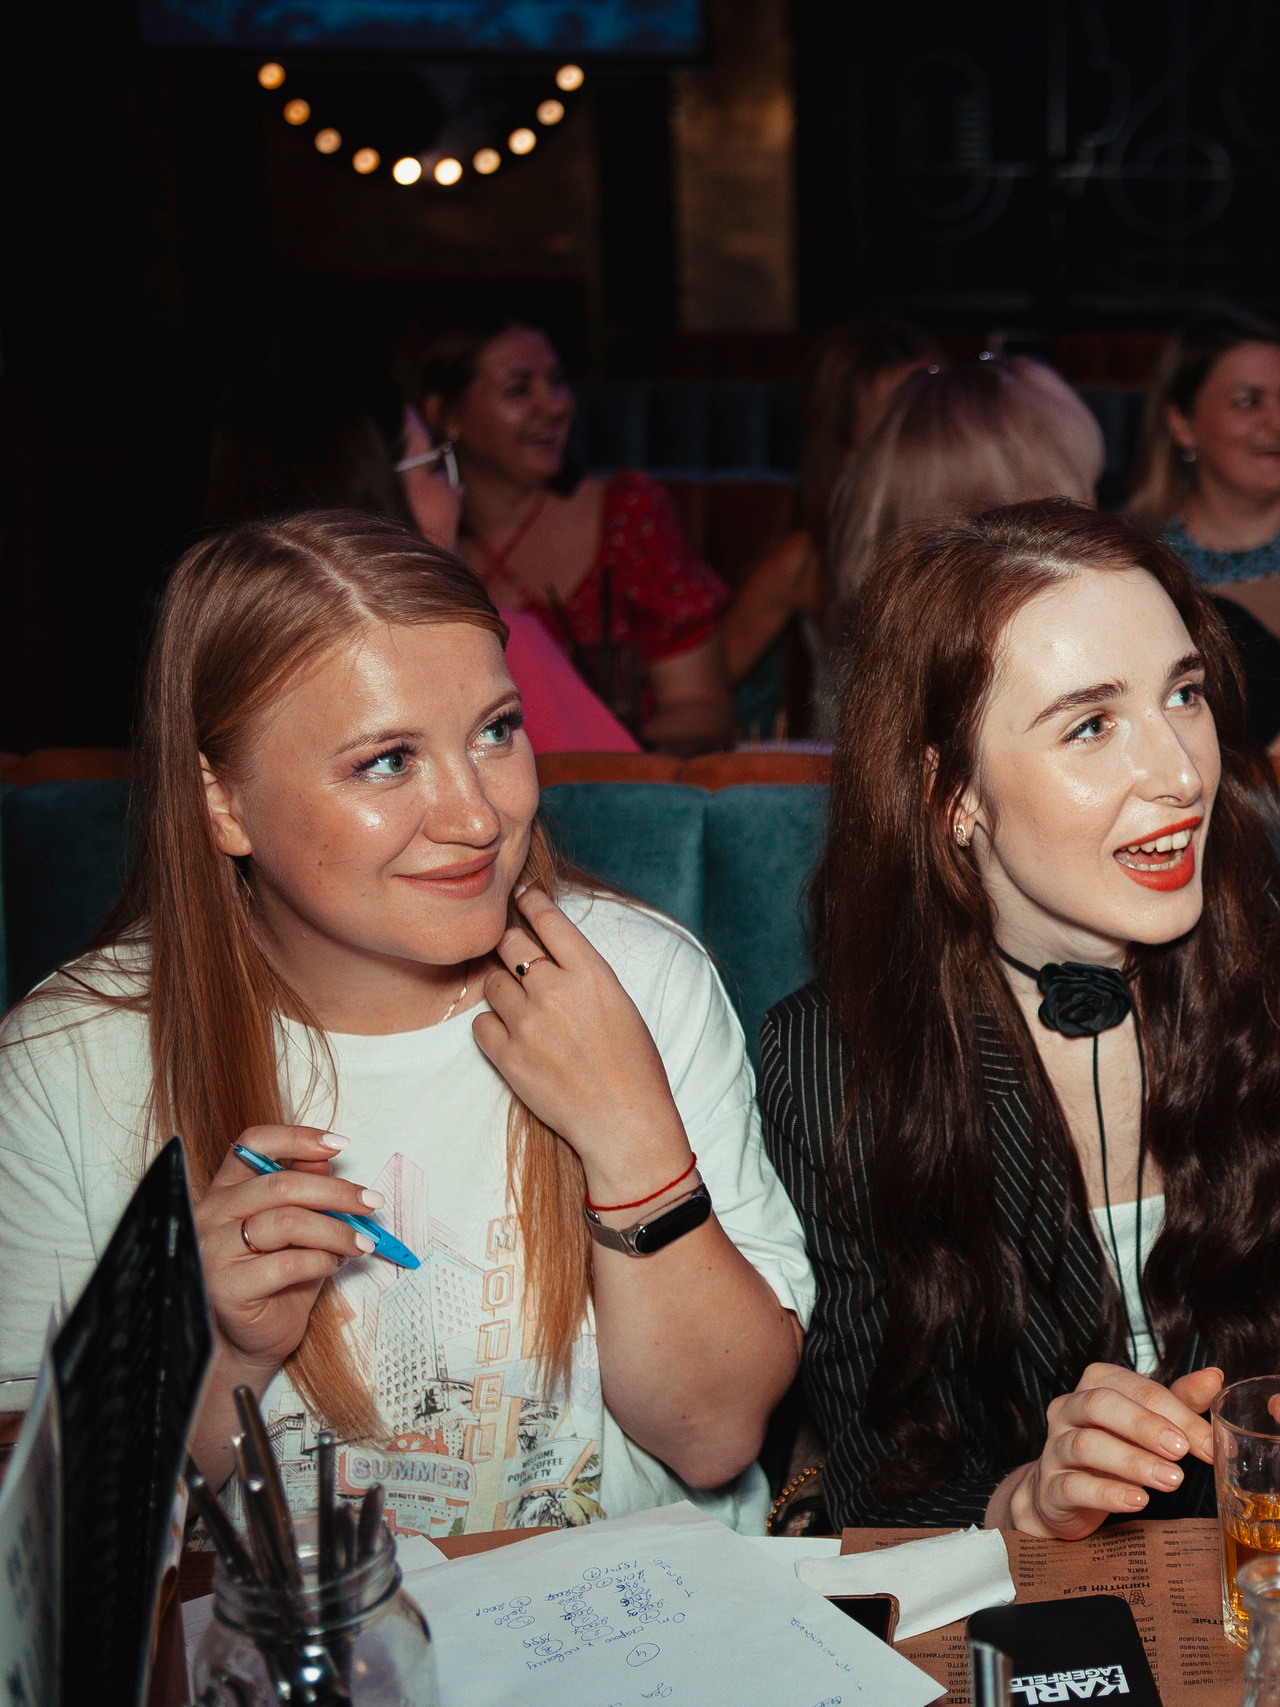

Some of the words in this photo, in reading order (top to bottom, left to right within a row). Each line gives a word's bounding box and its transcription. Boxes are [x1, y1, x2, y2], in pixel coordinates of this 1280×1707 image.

[471, 1217, 519, 1466] MOTEL
[352, 1457, 471, 1490] SUMMER
[532, 1458, 564, 1471] COFFEE
[542, 1469, 552, 1477] TV
[526, 1646, 581, 1670] новому
[1009, 1665, 1124, 1687] LAGERFELD
[1009, 1674, 1130, 1705] KARL
